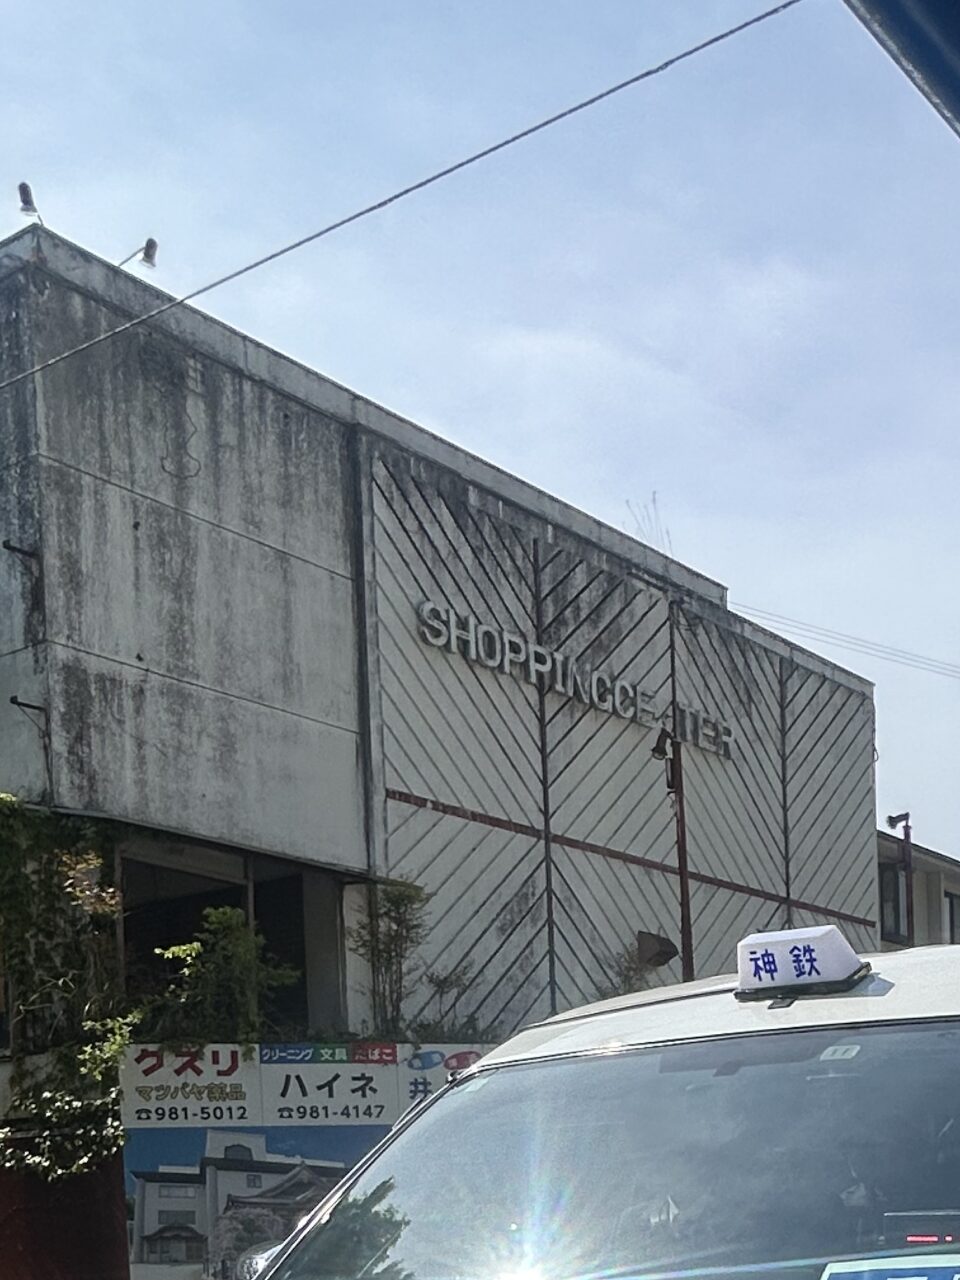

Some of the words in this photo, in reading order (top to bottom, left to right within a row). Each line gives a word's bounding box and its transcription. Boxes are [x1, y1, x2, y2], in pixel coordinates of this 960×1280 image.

[749, 944, 821, 982] 神鉄
[134, 1048, 239, 1077] クスリ
[261, 1047, 315, 1061] クリーニング
[320, 1047, 347, 1061] 文具
[280, 1073, 379, 1099] ハイネ
[155, 1106, 248, 1121] 981-5012
[296, 1105, 385, 1120] 981-4147
